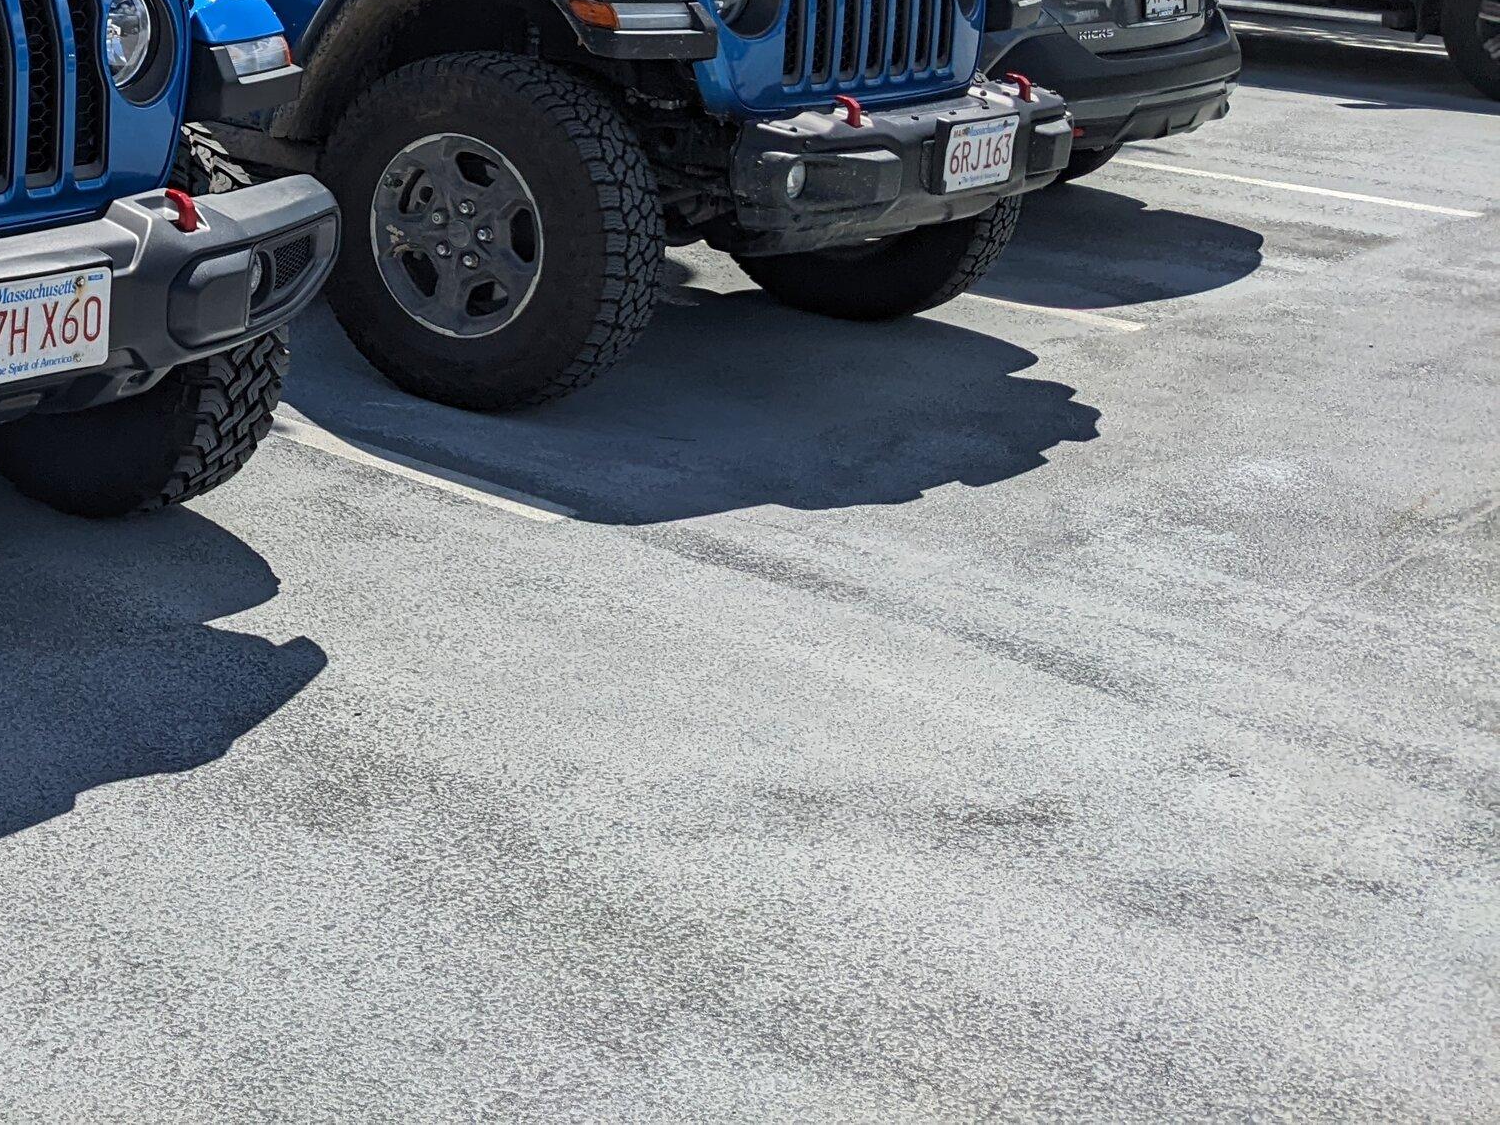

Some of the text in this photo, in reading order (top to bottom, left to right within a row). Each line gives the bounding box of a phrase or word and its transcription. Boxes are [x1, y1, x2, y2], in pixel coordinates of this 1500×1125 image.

[1079, 28, 1115, 40] KICKS
[8, 361, 29, 375] Spirit
[31, 357, 40, 370] of
[40, 355, 73, 369] America
